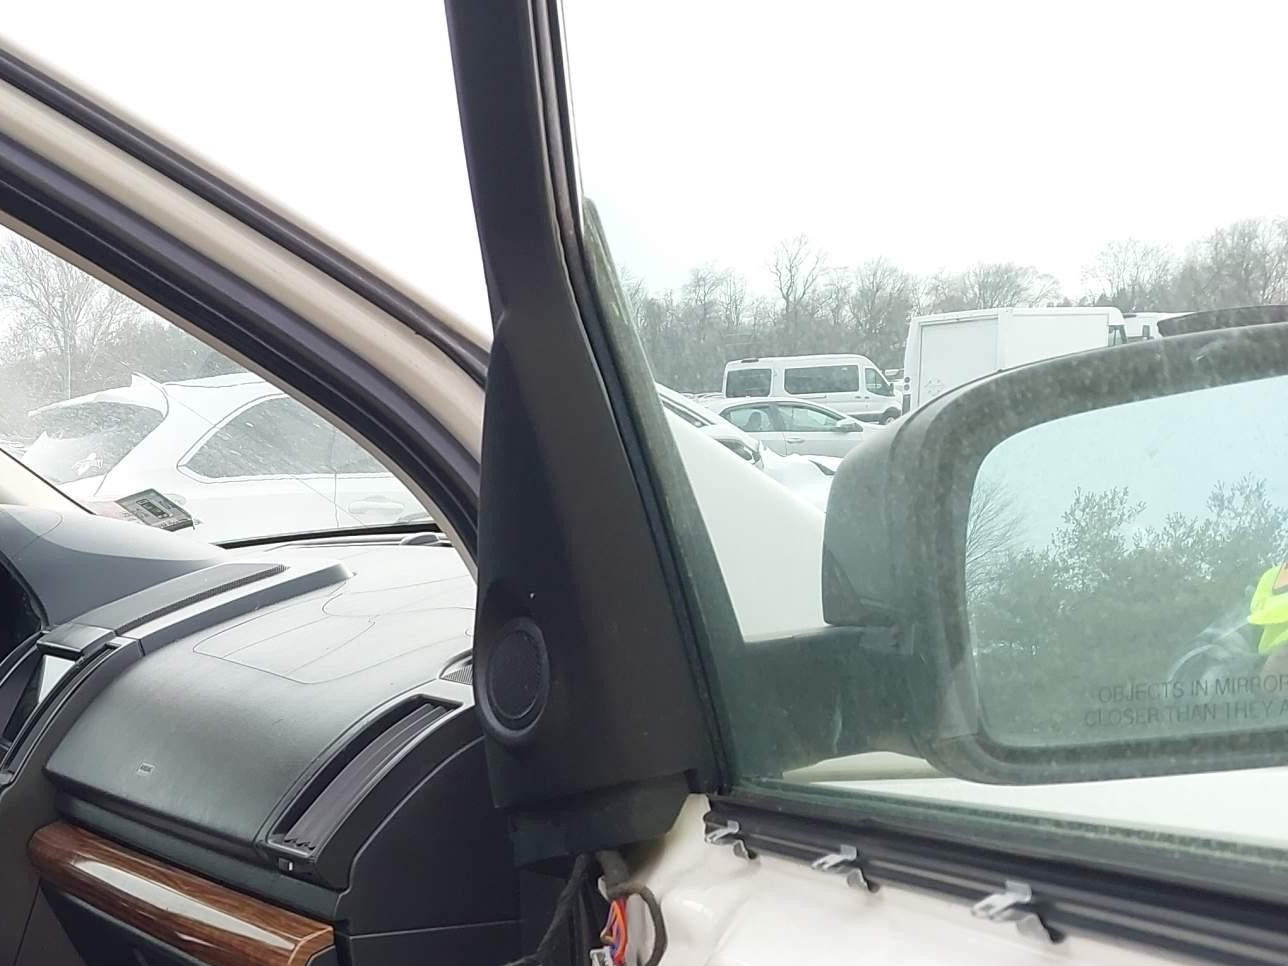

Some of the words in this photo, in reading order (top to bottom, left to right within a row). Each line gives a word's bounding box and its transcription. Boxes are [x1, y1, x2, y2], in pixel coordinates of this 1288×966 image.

[1098, 679, 1185, 703] OBJECTS
[1191, 679, 1208, 697] IN
[1084, 707, 1160, 728] CLOSER
[1166, 703, 1216, 722] THAN
[1225, 700, 1273, 720] THEY
